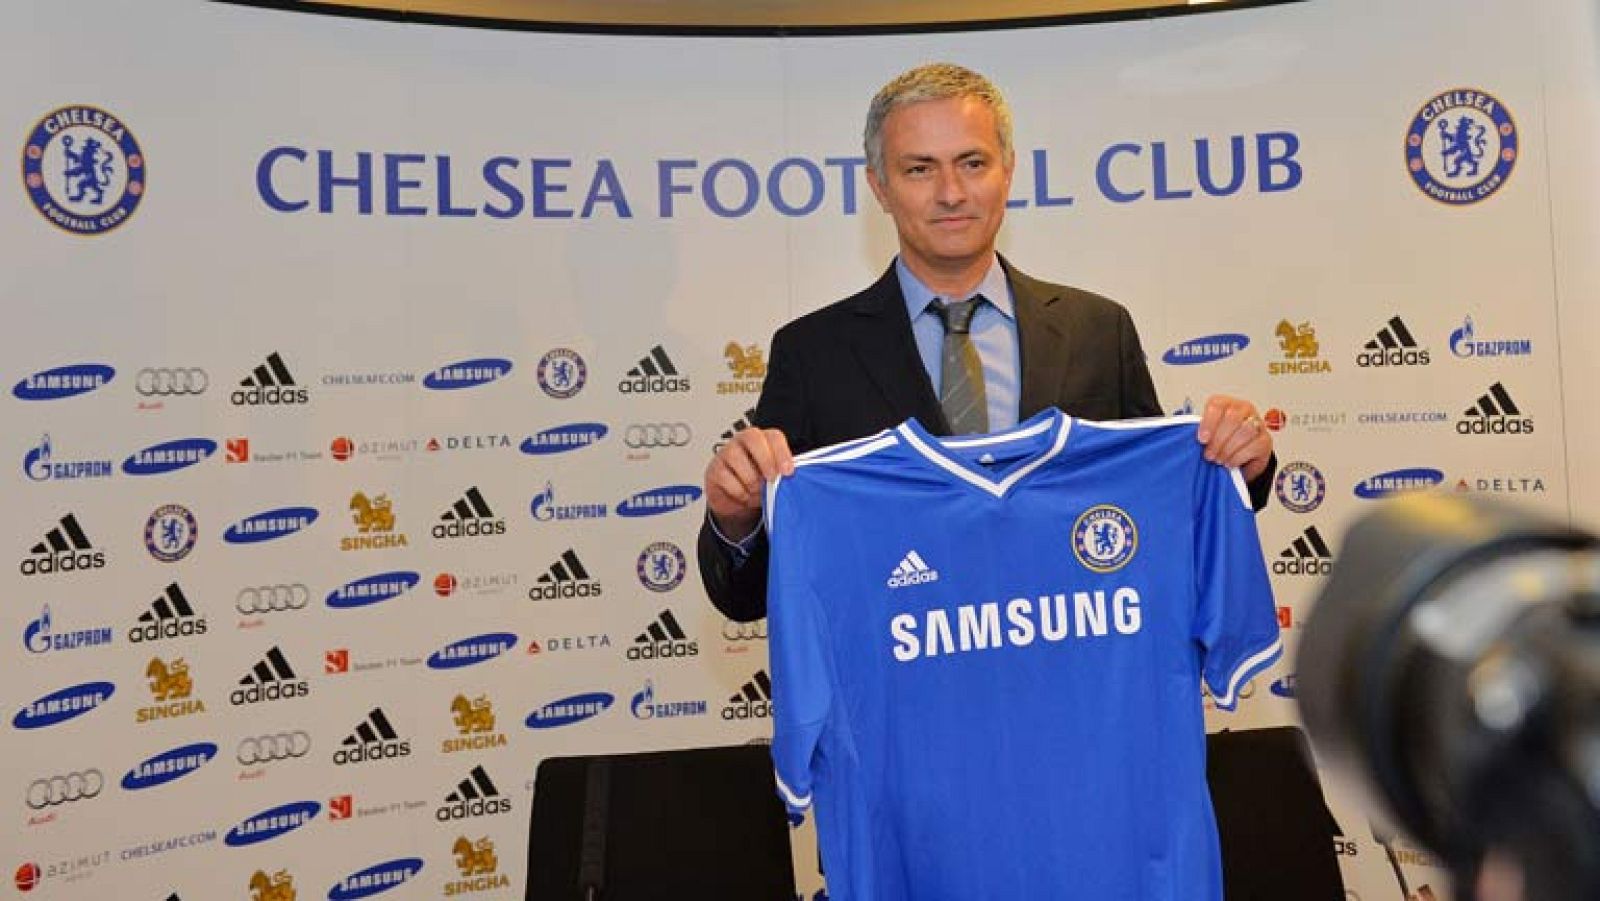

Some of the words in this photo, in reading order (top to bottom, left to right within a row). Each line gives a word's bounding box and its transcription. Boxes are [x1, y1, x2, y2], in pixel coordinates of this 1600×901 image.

[1423, 92, 1494, 121] CHELSEA
[45, 109, 124, 141] CHELSEA
[255, 146, 633, 219] CHELSEA
[657, 149, 1074, 218] FOOTL
[1095, 130, 1303, 203] CLUB
[1172, 342, 1243, 357] SAMSUNG
[1356, 348, 1430, 368] adidas
[1476, 339, 1532, 357] GAZPROM
[433, 367, 505, 382] SAMSUNG
[1268, 360, 1332, 376] SINGHA
[26, 375, 106, 391] SAMSUNG
[618, 376, 690, 394] adidas
[231, 384, 309, 406] adidas
[1456, 415, 1534, 435] adidas
[447, 435, 511, 449] DELTA
[530, 431, 601, 447] SAMSUNG
[132, 447, 209, 465] SAMSUNG
[54, 460, 112, 479] GAZPROM
[1477, 478, 1546, 492] DELTA
[626, 493, 696, 509] SAMSUNG
[555, 503, 607, 520] GAZPROM
[234, 516, 310, 535] SAMSUNG
[431, 518, 506, 539] adidas
[339, 533, 408, 551] SINGHA
[20, 550, 105, 576] adidas
[1272, 557, 1333, 576] adida
[887, 569, 940, 589] adidas
[336, 581, 412, 600] SAMSUNG
[529, 581, 602, 601] adidas
[128, 617, 208, 643] adidas
[890, 586, 1142, 662] SAMSUNG
[54, 628, 112, 650] GAZPROM
[547, 634, 611, 651] DELTA
[438, 641, 510, 660] SAMSUNG
[626, 640, 698, 660] adidas
[230, 680, 309, 706] adidas
[25, 692, 107, 719] SAMSUNG
[135, 699, 206, 723] SINGHA
[535, 701, 607, 720] SAMSUNG
[655, 700, 707, 718] GAZPROM
[721, 701, 774, 720] adid
[333, 739, 412, 766] adidas
[442, 733, 508, 754] SINGHA
[132, 752, 210, 780] SAMSUNG
[435, 796, 512, 823] adidas
[236, 810, 313, 836] SAMSUNG
[339, 868, 416, 893] SAMSUNG
[444, 873, 510, 897] SINGHA
